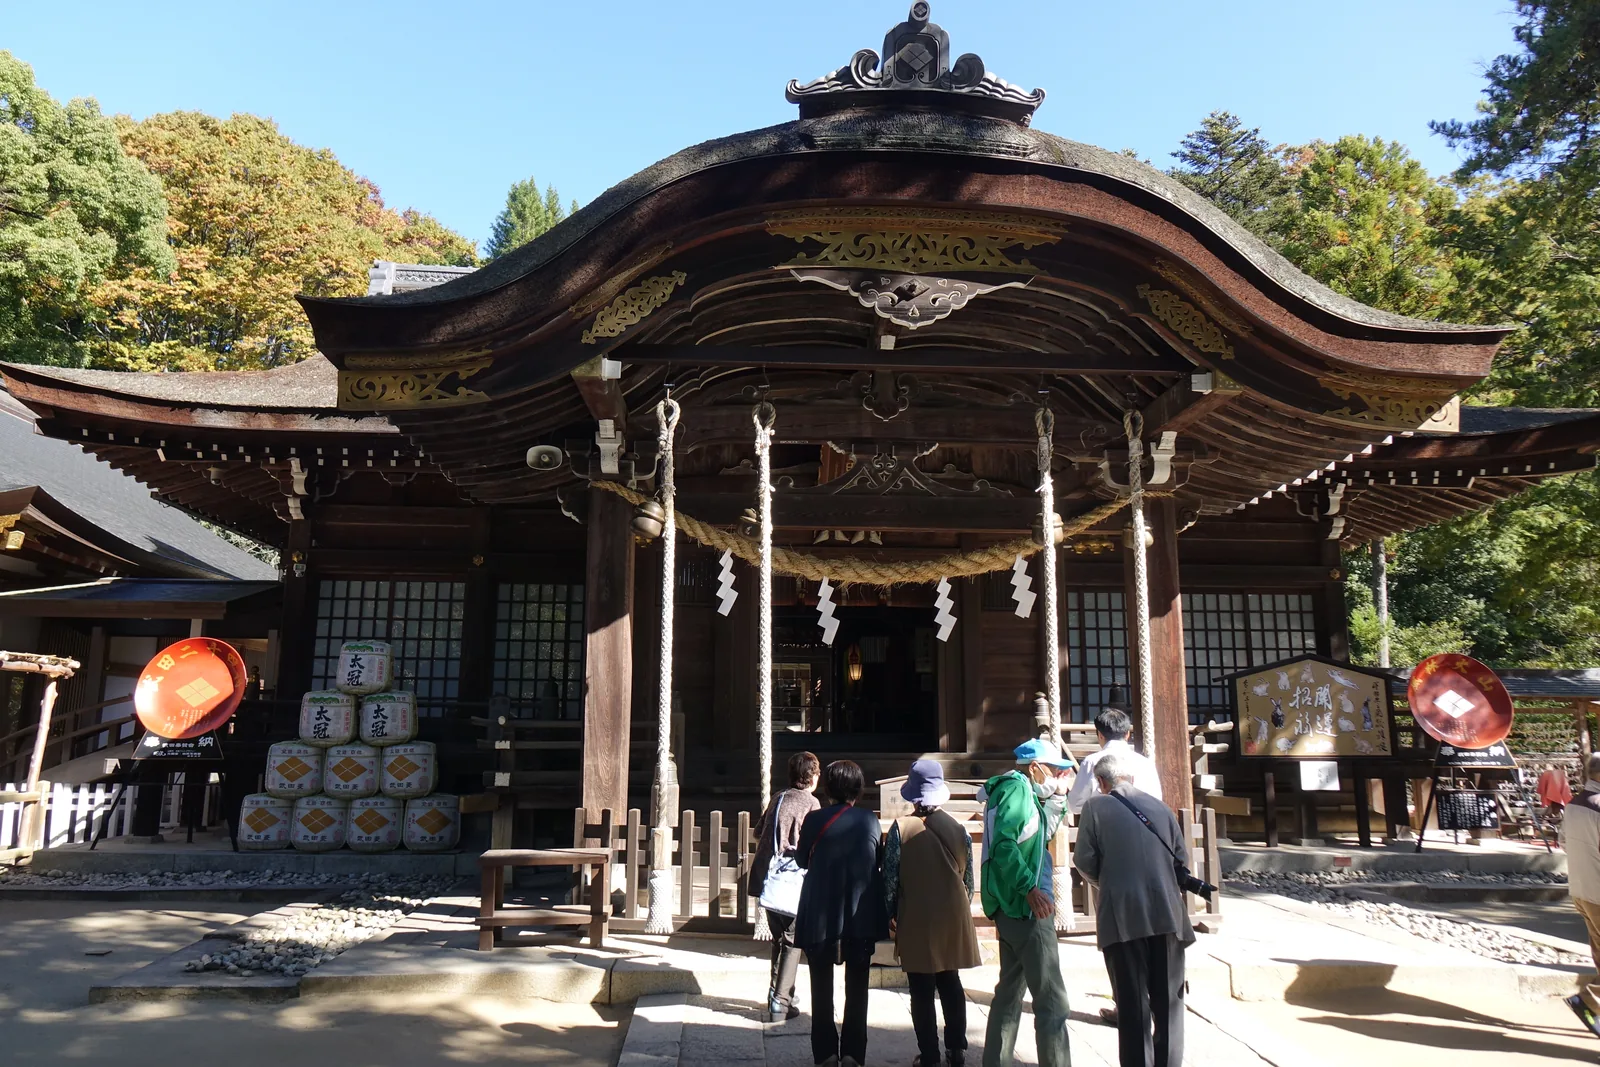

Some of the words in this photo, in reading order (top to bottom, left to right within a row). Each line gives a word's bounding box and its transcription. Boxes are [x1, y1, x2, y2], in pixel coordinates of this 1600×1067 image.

[347, 654, 365, 686] 太冠
[313, 705, 331, 738] 太冠
[371, 703, 388, 737] 太冠
[1314, 683, 1337, 738] 開運
